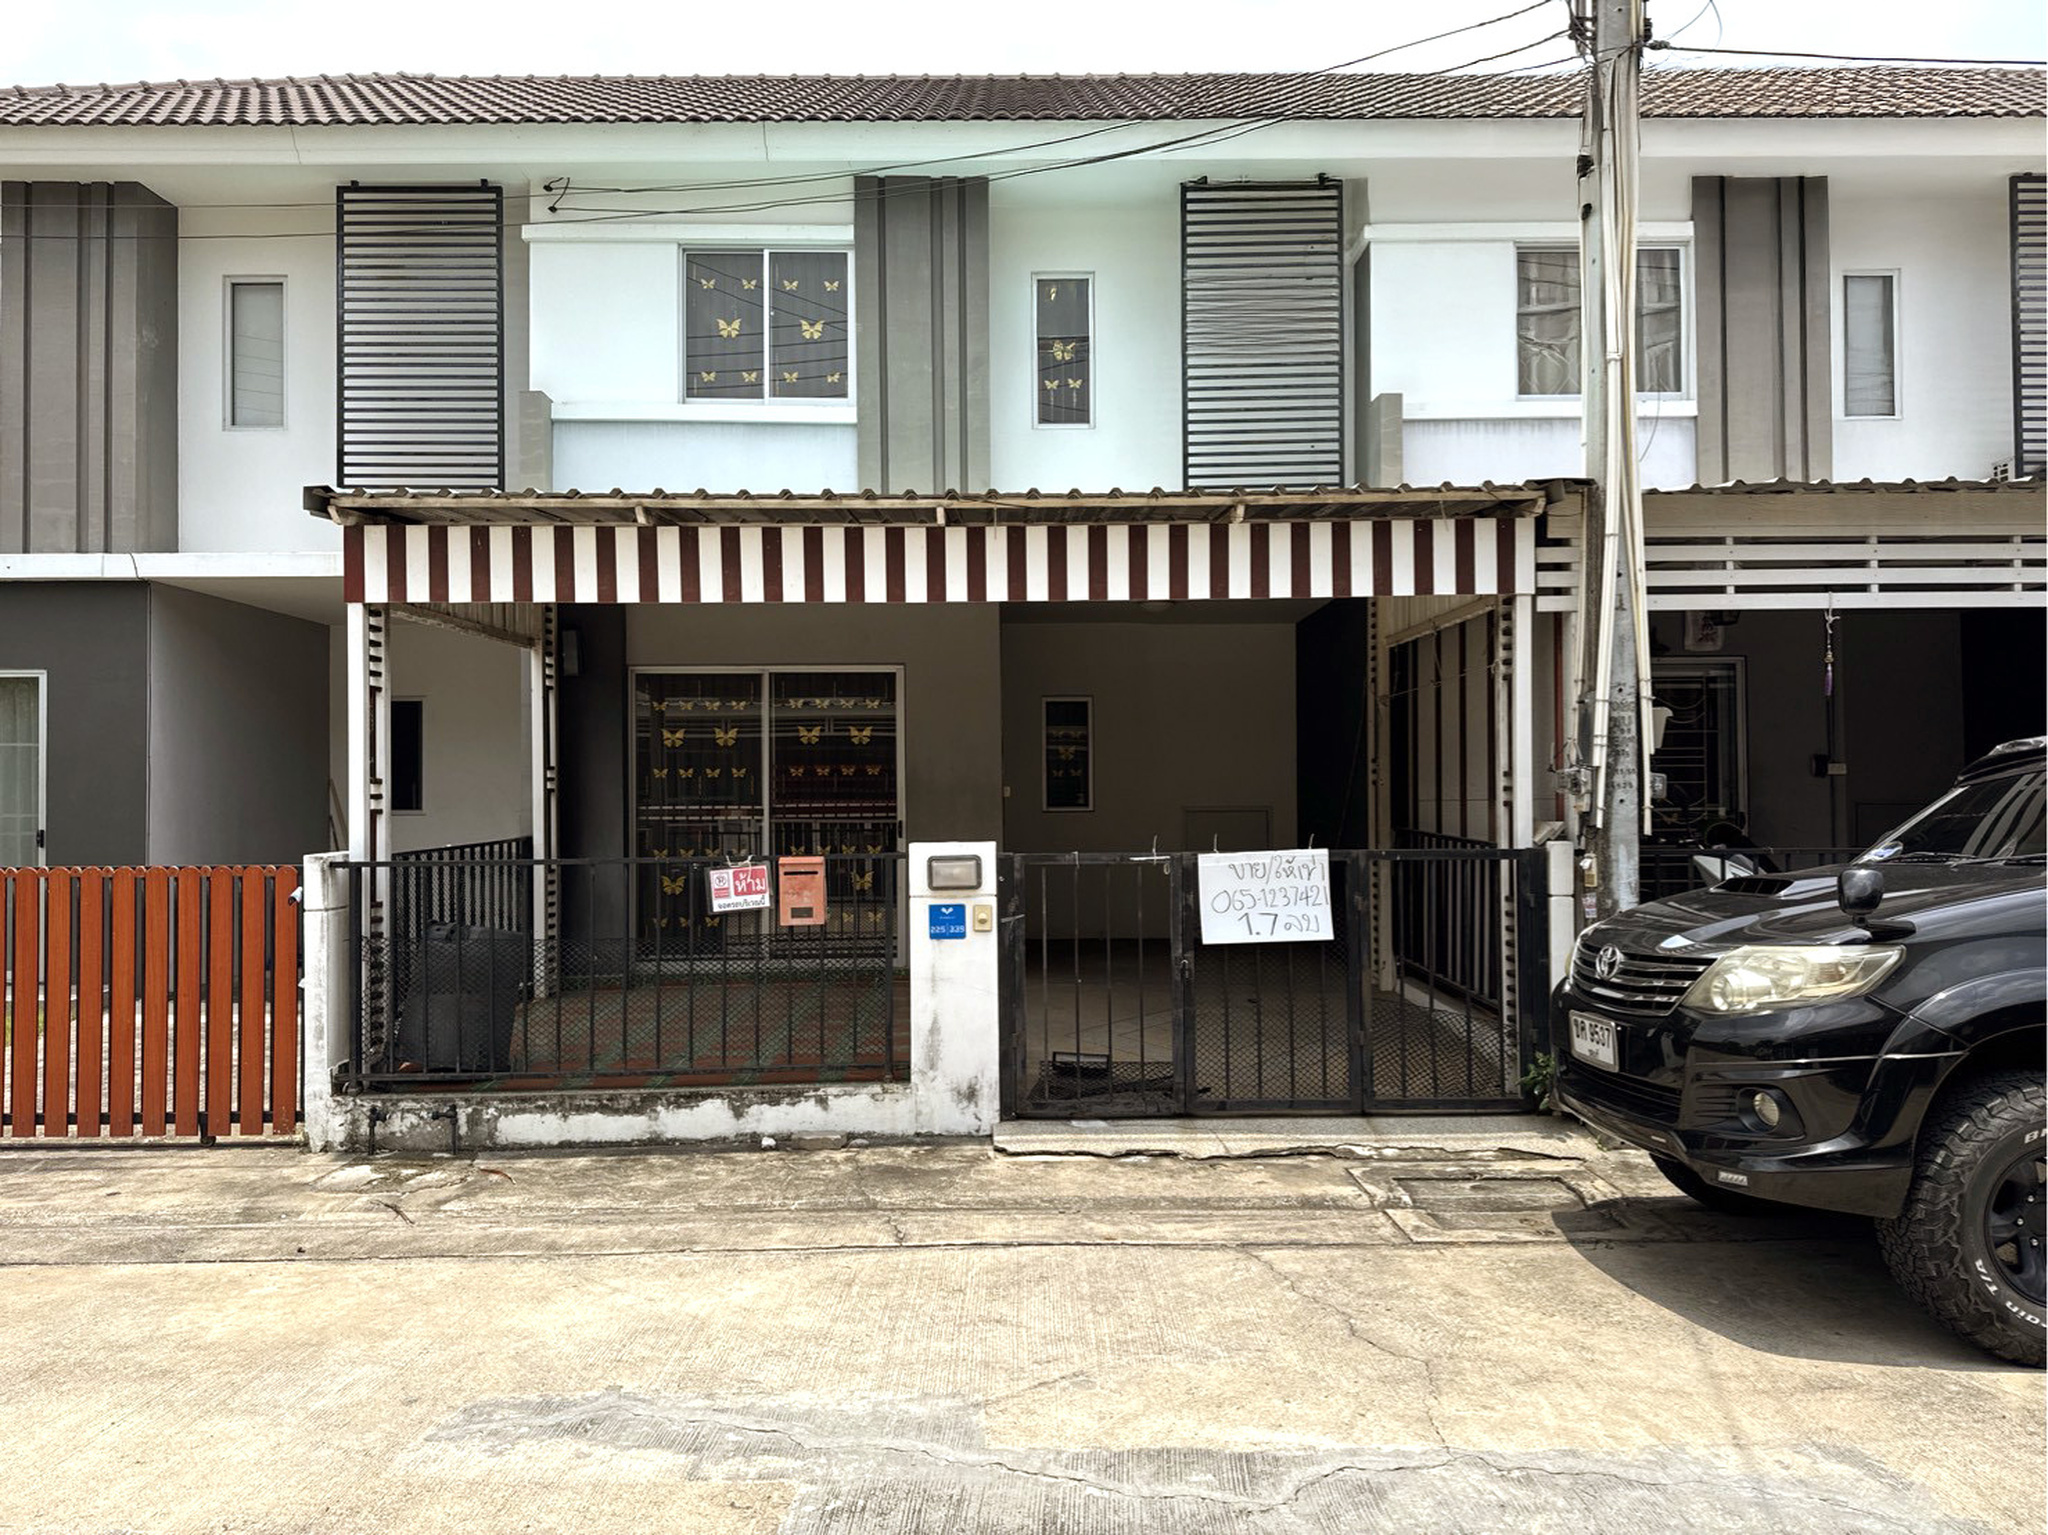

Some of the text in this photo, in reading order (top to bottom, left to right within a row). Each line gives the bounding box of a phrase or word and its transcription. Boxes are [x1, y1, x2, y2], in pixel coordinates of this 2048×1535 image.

[733, 872, 765, 893] ห้าม
[1211, 885, 1329, 914] 065-1237421
[1975, 1259, 1998, 1296] T/A
